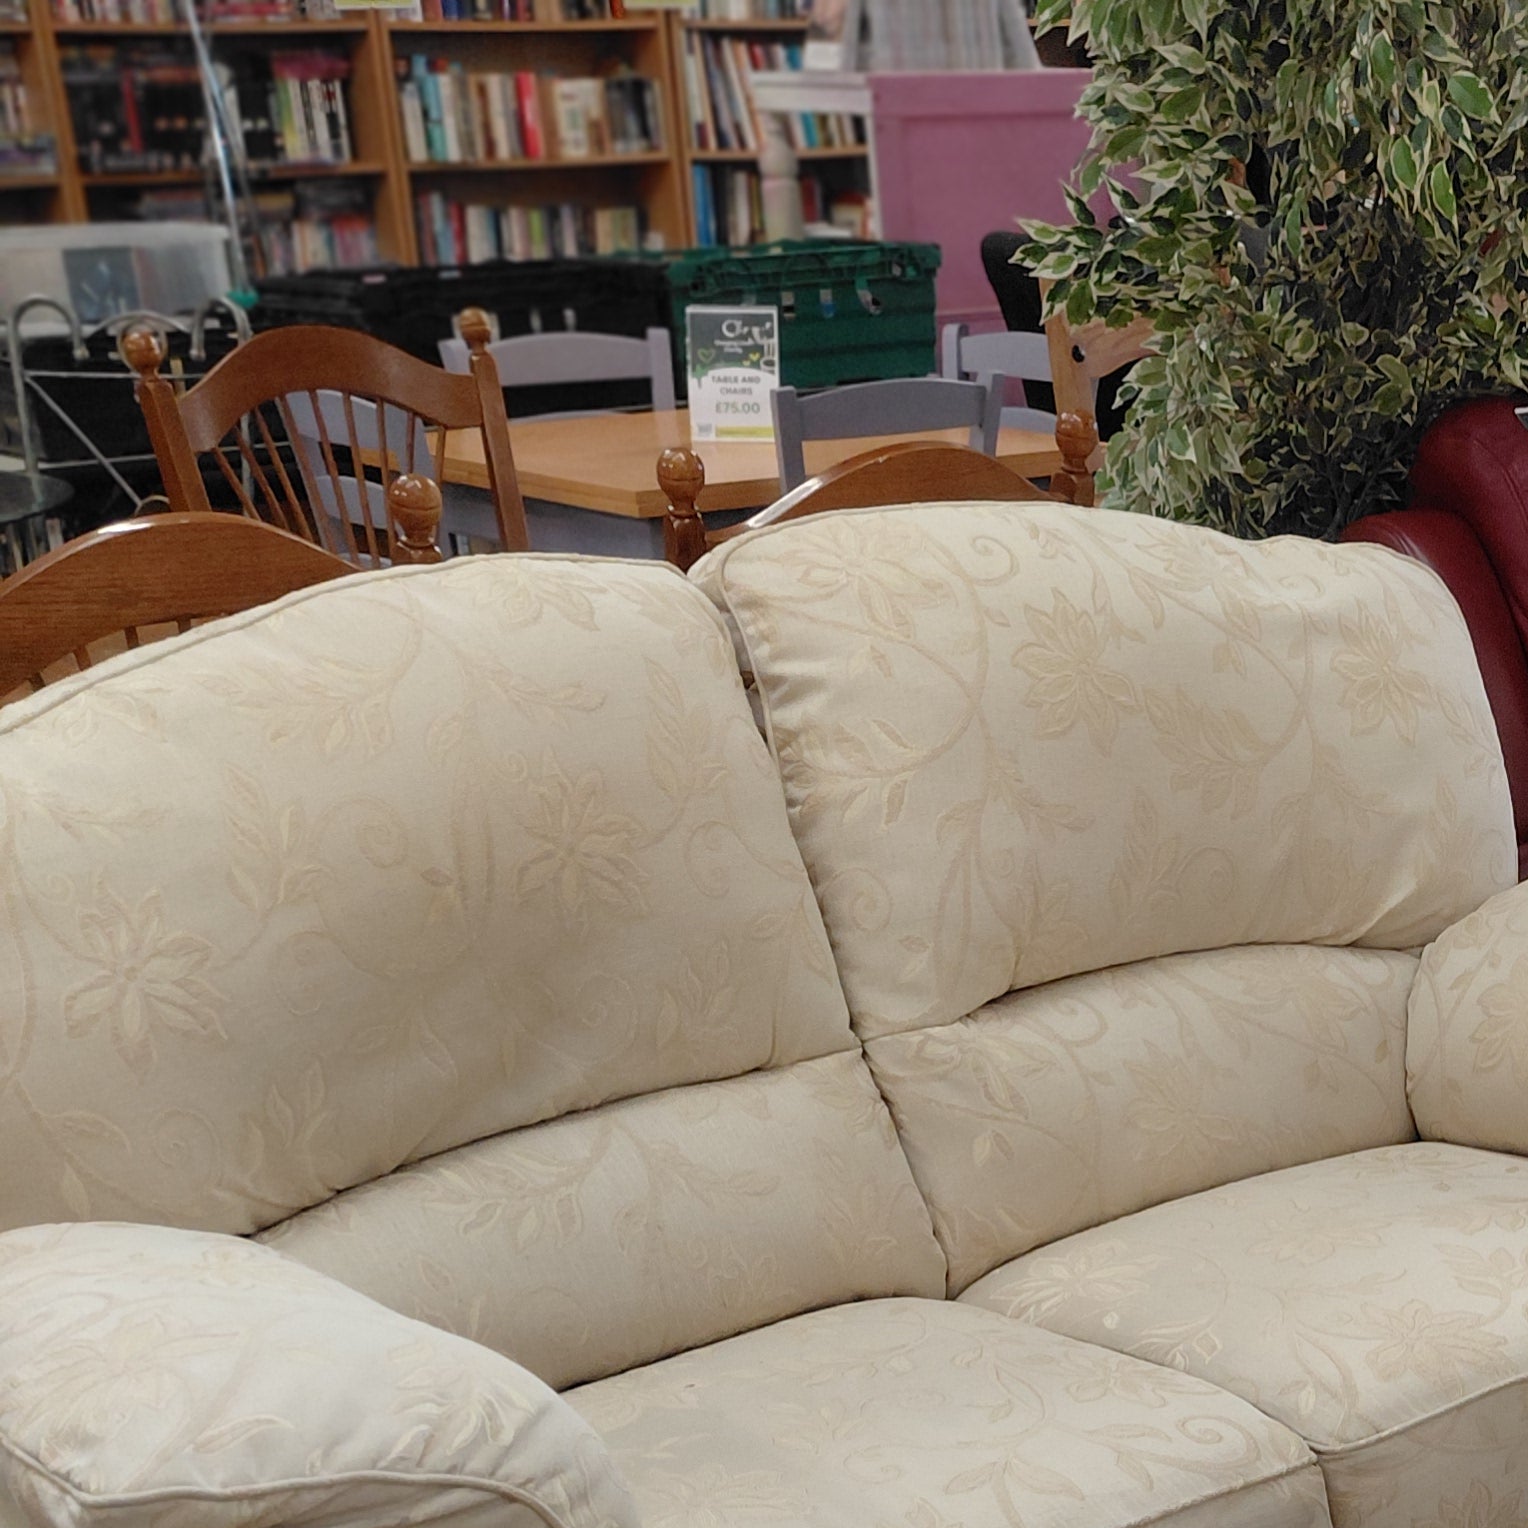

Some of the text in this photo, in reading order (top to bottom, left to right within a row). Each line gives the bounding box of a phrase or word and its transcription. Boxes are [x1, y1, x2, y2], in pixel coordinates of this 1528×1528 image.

[742, 375, 761, 384] AND
[719, 387, 753, 396] CHAIRS
[715, 402, 761, 414] £75.00
